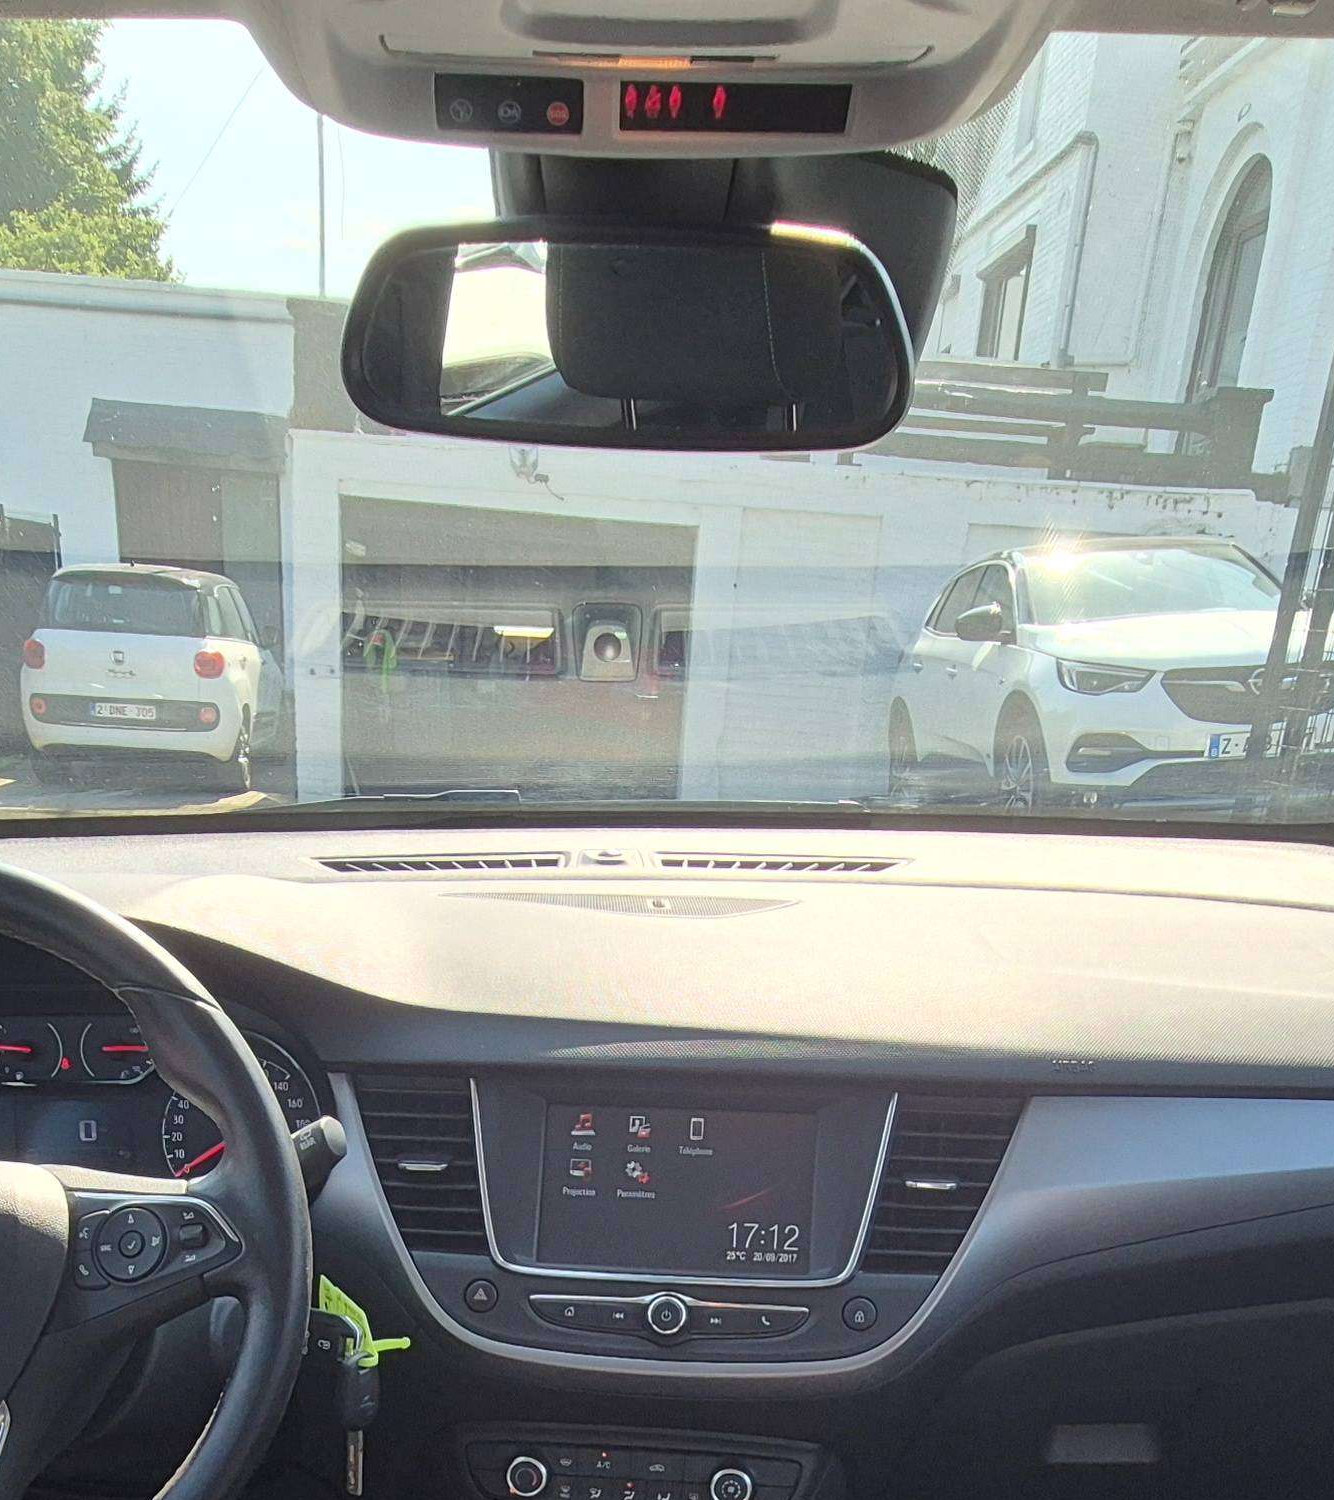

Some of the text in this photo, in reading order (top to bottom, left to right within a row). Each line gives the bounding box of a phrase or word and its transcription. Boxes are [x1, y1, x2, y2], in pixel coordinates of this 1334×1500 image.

[273, 1081, 289, 1092] 140
[177, 1099, 190, 1110] 40
[173, 1114, 184, 1125] 30
[171, 1131, 183, 1142] 20
[173, 1148, 185, 1159] 10
[727, 1222, 799, 1251] 17:12
